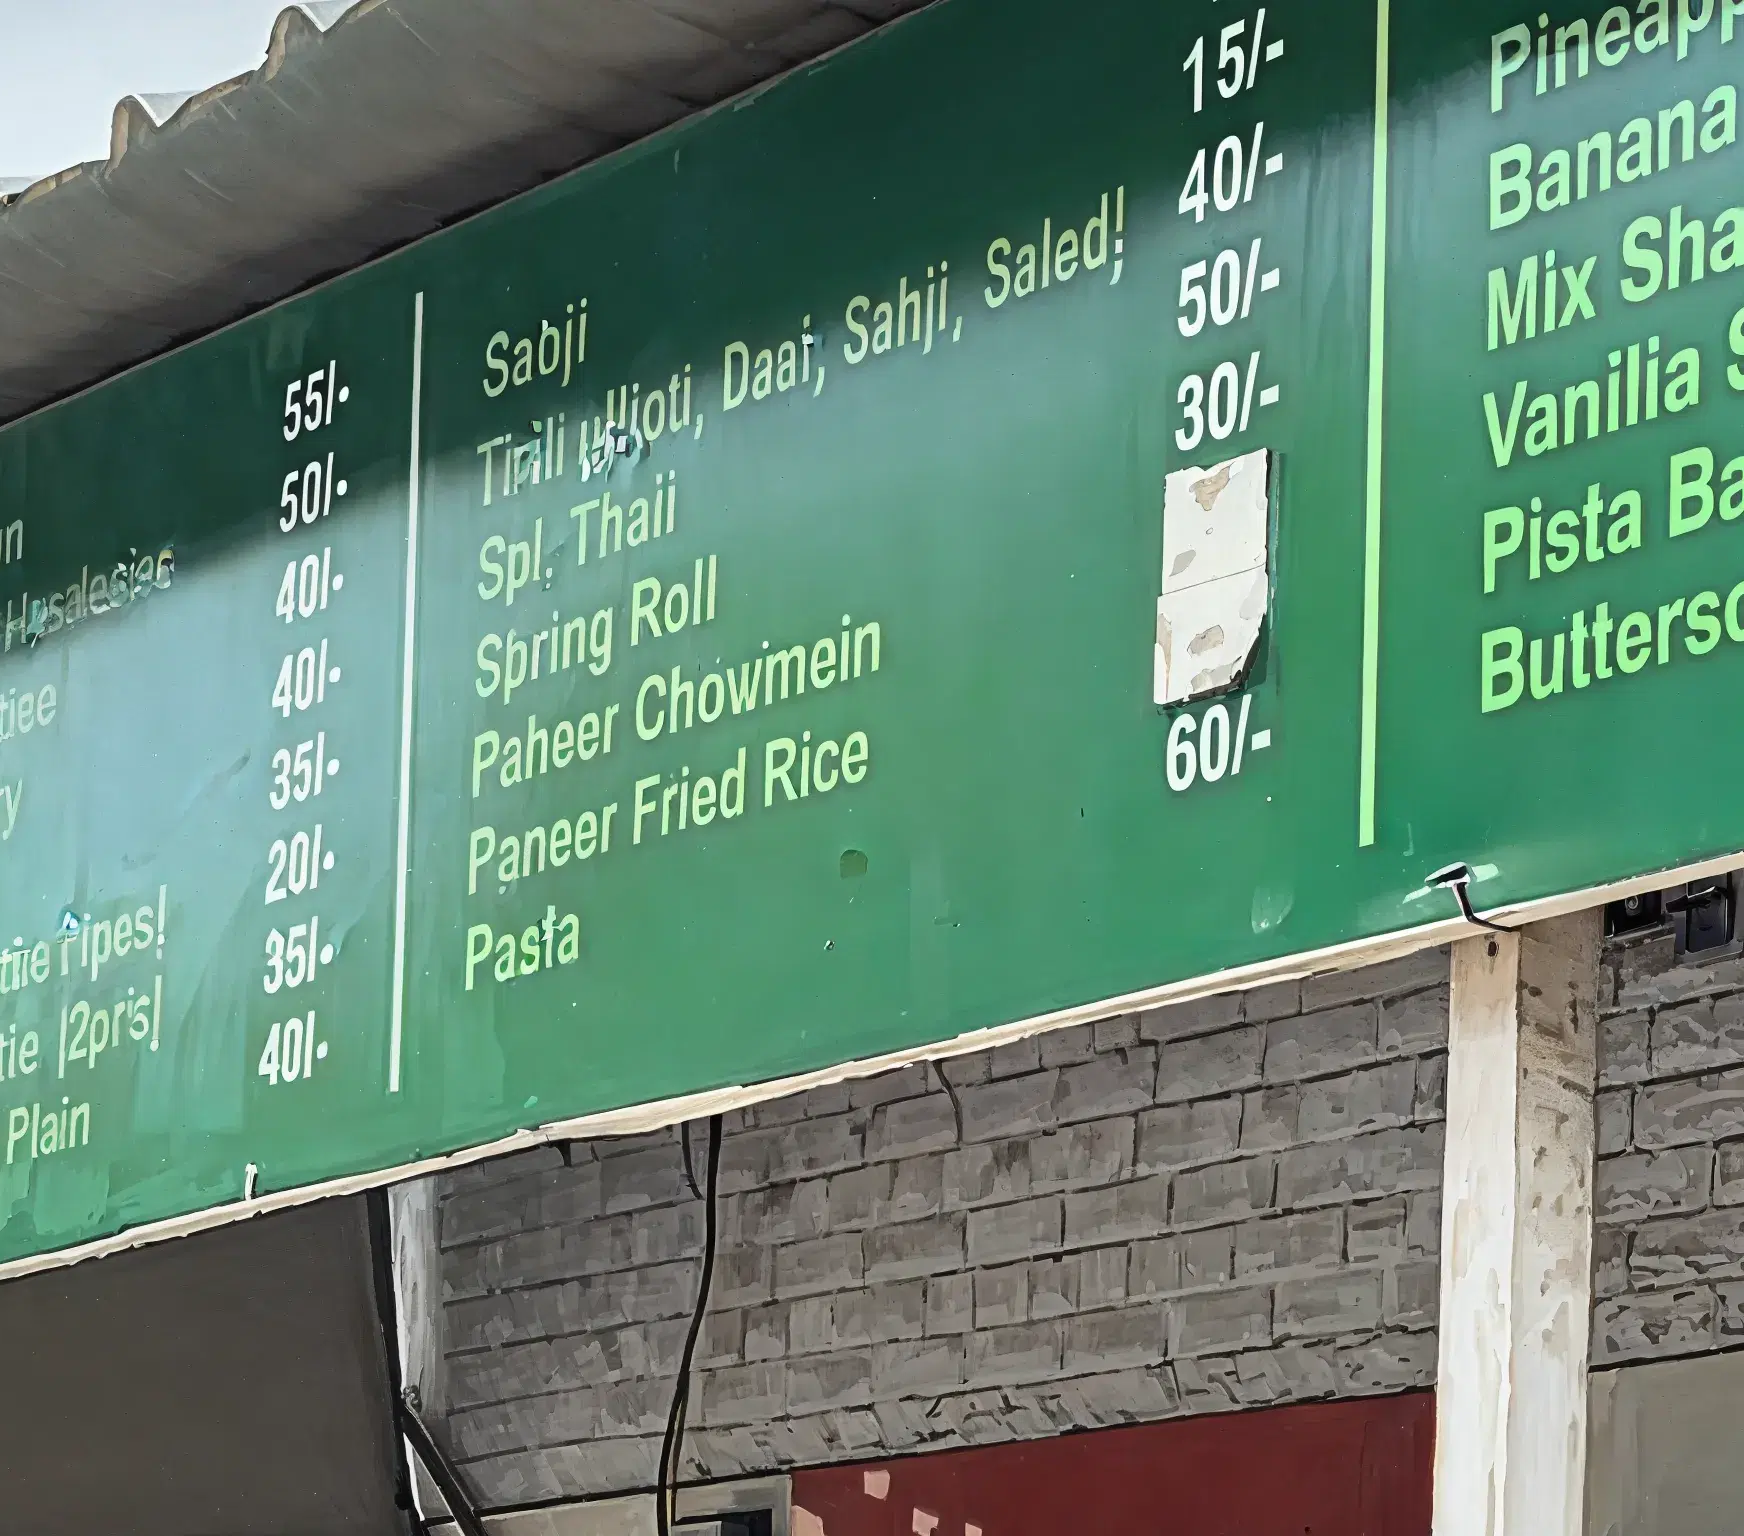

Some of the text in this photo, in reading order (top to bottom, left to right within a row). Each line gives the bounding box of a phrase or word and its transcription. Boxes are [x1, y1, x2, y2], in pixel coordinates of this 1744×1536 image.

[1182, 8, 1284, 113] 15/-
[1178, 121, 1283, 224] 40/-
[1489, 84, 1737, 231] Banana
[1177, 237, 1280, 338] 50/-
[1486, 250, 1597, 350] Mix
[1174, 350, 1279, 451] 30/-
[1482, 482, 1642, 594] Pista
[475, 555, 718, 705] Spring Roll
[635, 614, 881, 741] Chowmein
[1165, 694, 1270, 793] 60/-
[468, 729, 870, 895] Paneer Fried Rice
[464, 905, 580, 991] Pasta
[7, 1096, 90, 1165] Plain
